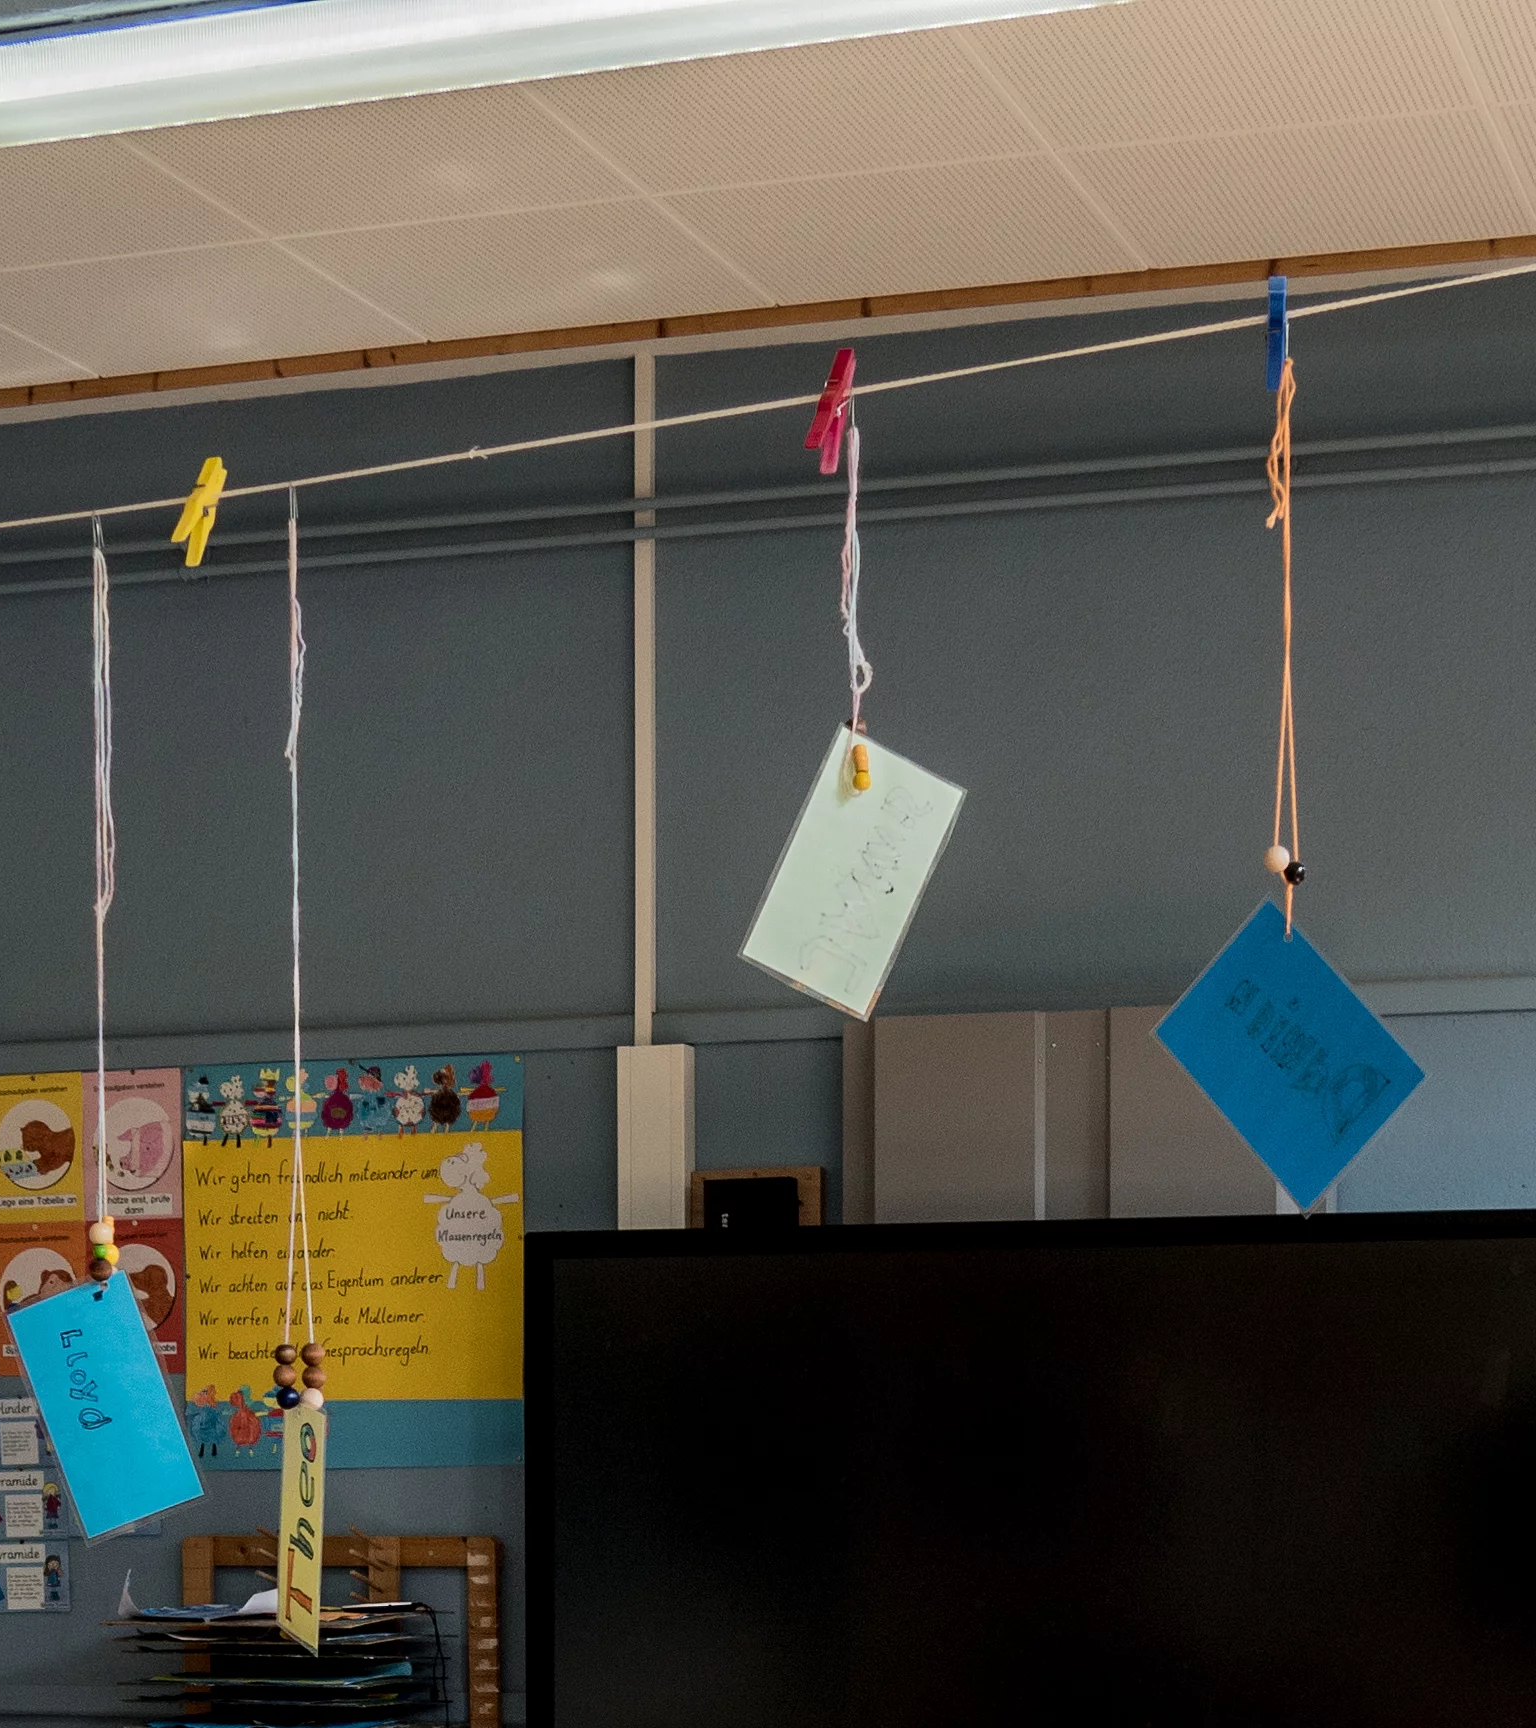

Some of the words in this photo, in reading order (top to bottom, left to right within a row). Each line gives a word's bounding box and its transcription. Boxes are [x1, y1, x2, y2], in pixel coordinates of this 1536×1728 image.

[196, 1166, 225, 1187] Wir
[231, 1162, 270, 1193] gehen
[16, 1197, 35, 1206] eine
[36, 1195, 66, 1206] Tabelle
[67, 1196, 78, 1205] an
[124, 1206, 145, 1215] dann
[199, 1209, 221, 1226] Wir
[229, 1202, 278, 1226] streiten
[445, 1208, 486, 1220] Unsere
[438, 1228, 503, 1246] Klassenregeln
[199, 1245, 221, 1260] Wir
[231, 1241, 268, 1259] helfen
[199, 1275, 221, 1293] Wir
[229, 1273, 268, 1292] achten
[327, 1268, 384, 1296] Eigentum
[199, 1310, 219, 1325] Wir
[227, 1306, 269, 1325] werfen
[333, 1307, 350, 1324] die
[199, 1343, 219, 1359] Wir
[228, 1341, 275, 1360] beachte
[285, 1422, 317, 1622] Theo
